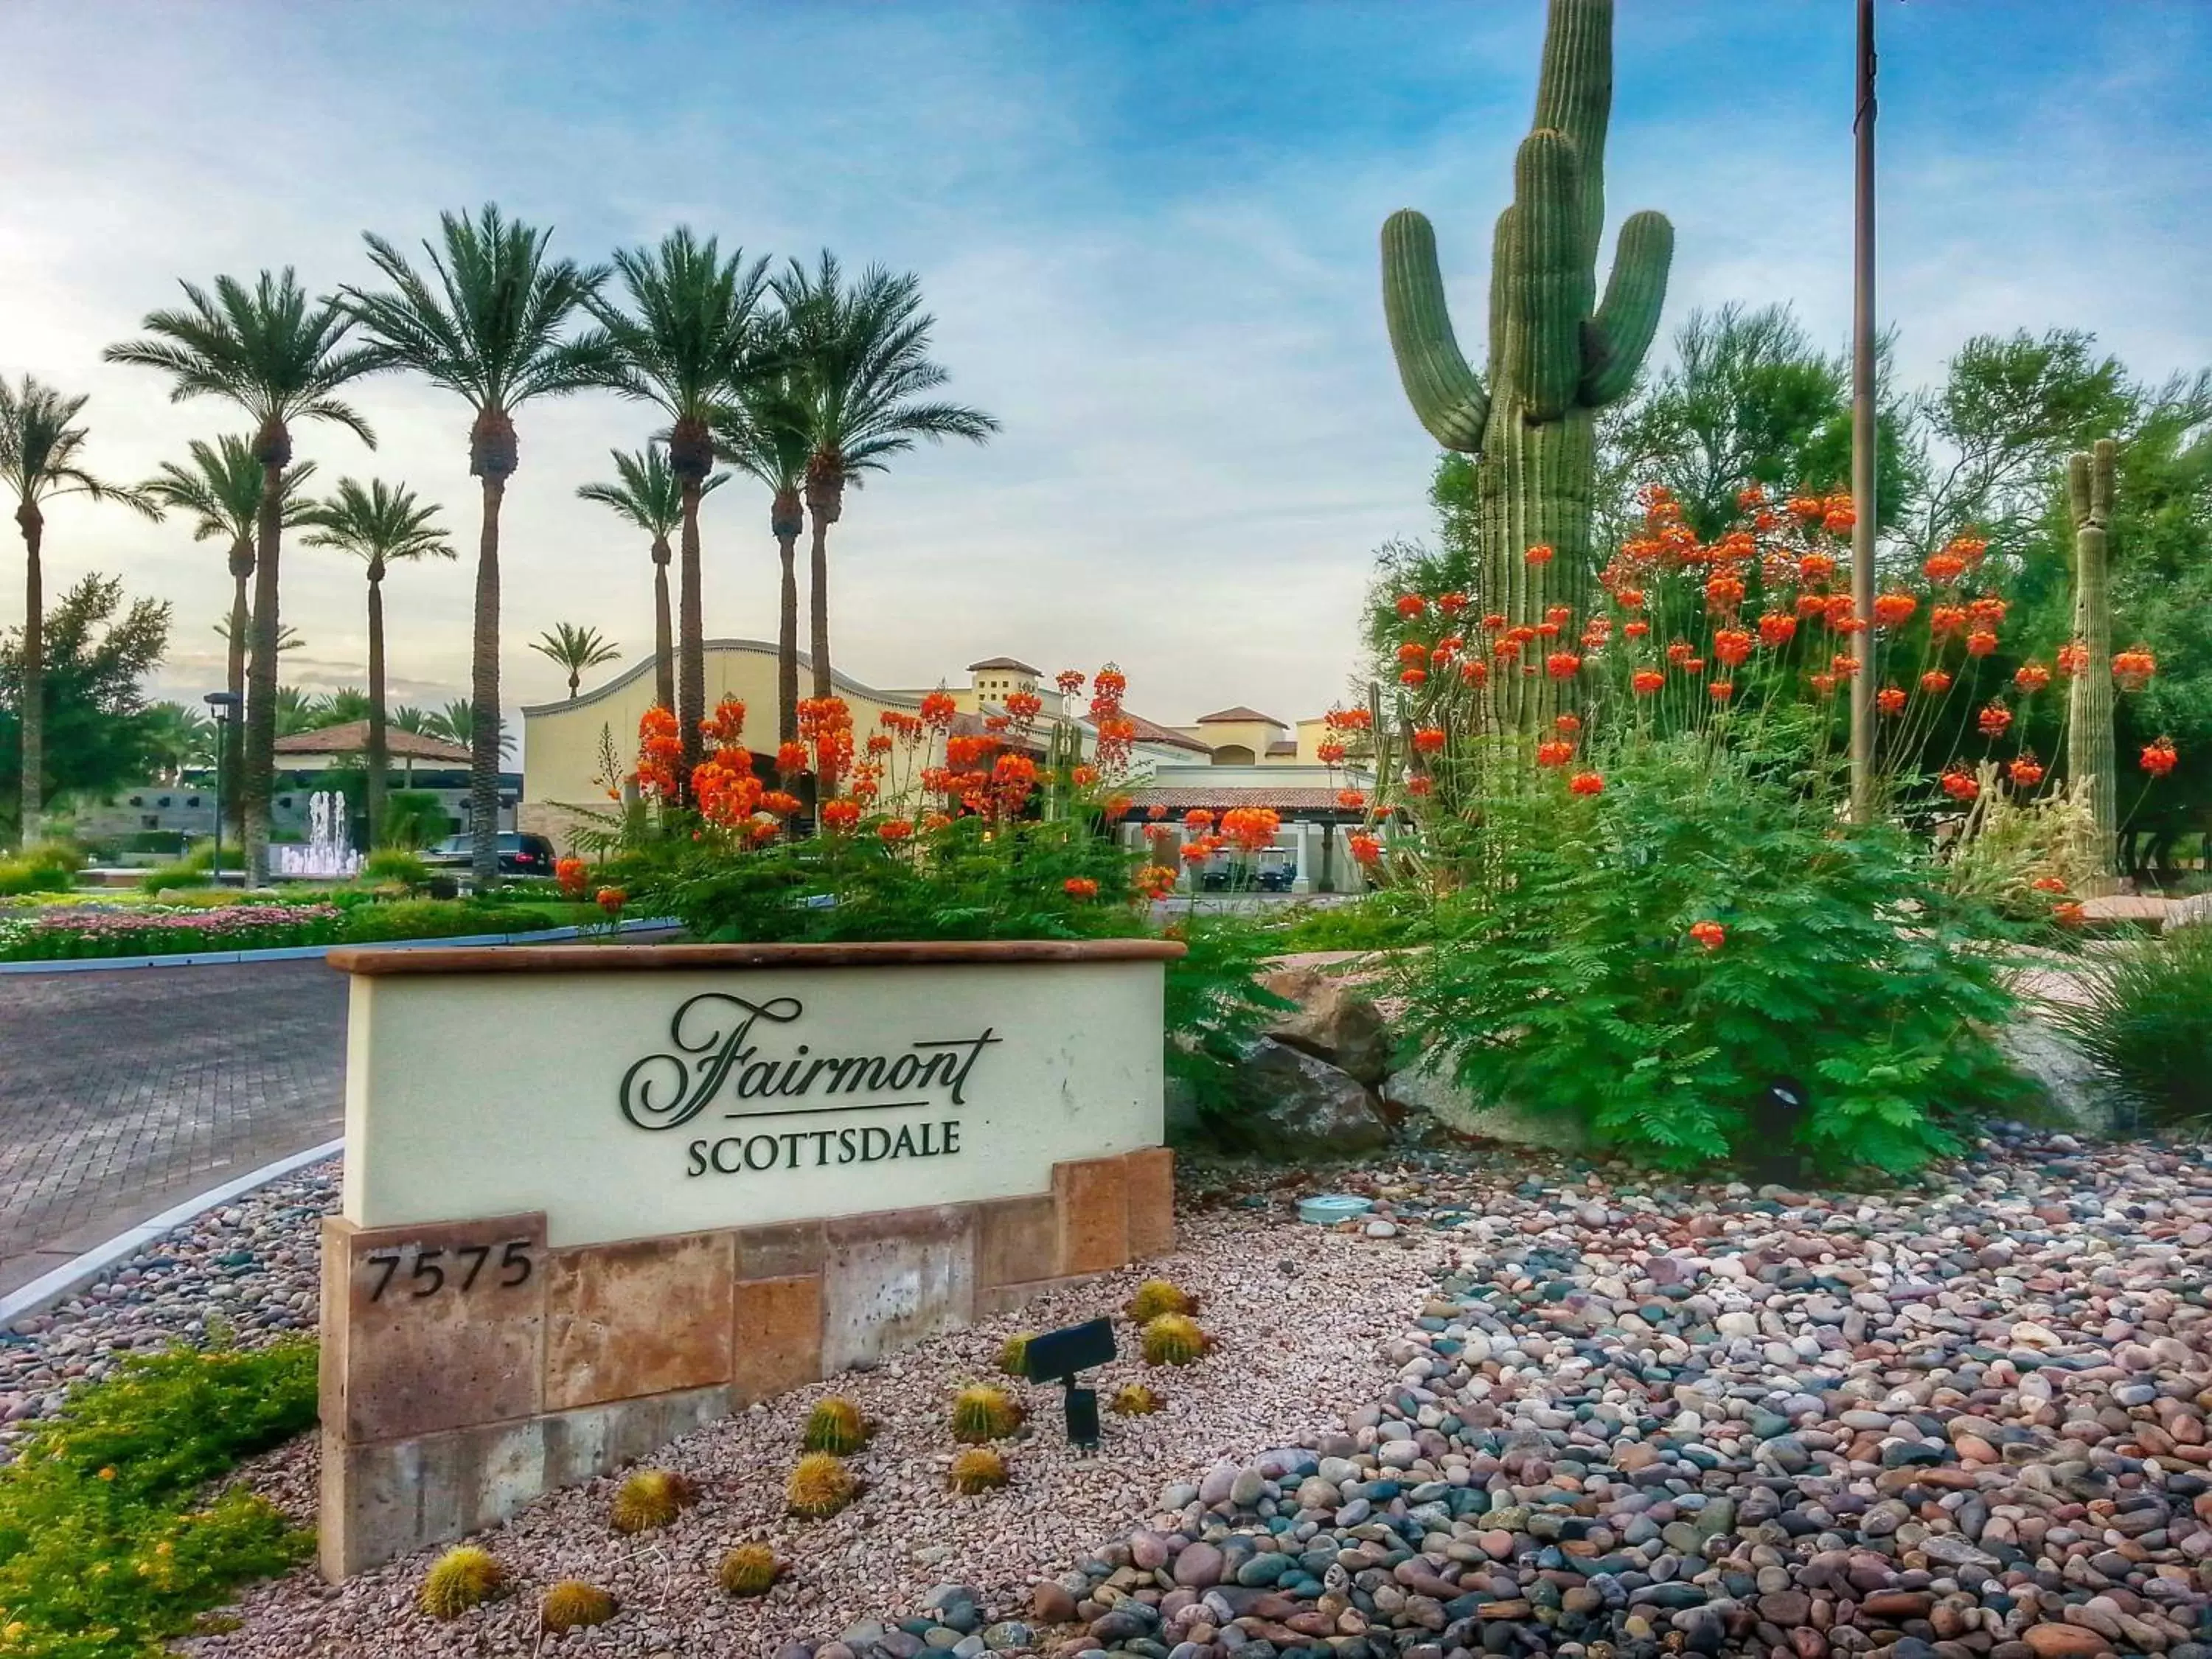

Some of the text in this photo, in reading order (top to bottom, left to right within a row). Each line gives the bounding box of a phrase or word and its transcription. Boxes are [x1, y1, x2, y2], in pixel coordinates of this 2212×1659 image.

[620, 992, 1004, 1130] Fairmont
[687, 1120, 961, 1178] SCOTTSDALE
[368, 1241, 532, 1302] 7575
